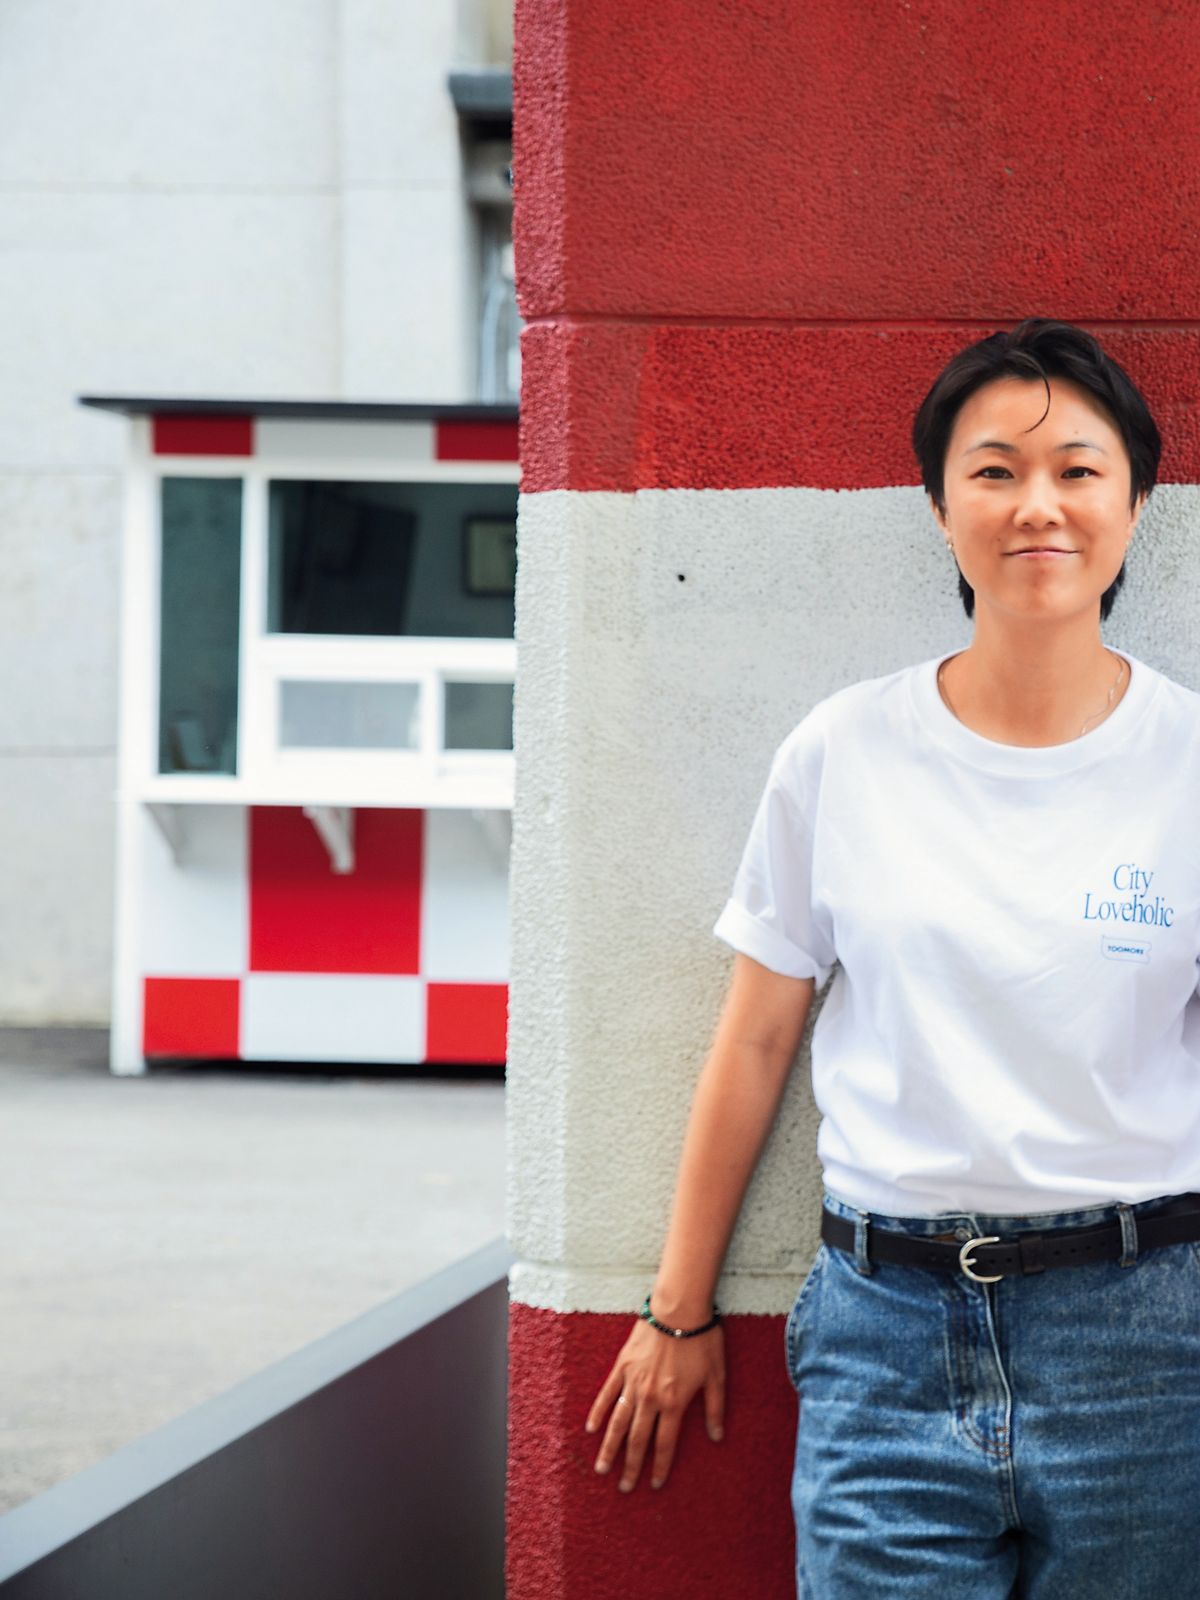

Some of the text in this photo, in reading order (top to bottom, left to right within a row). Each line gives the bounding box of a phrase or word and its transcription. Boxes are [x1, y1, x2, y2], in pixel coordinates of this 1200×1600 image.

[1113, 863, 1154, 898] City
[1083, 893, 1174, 928] Loveholic
[1107, 945, 1144, 955] TOOMORE
